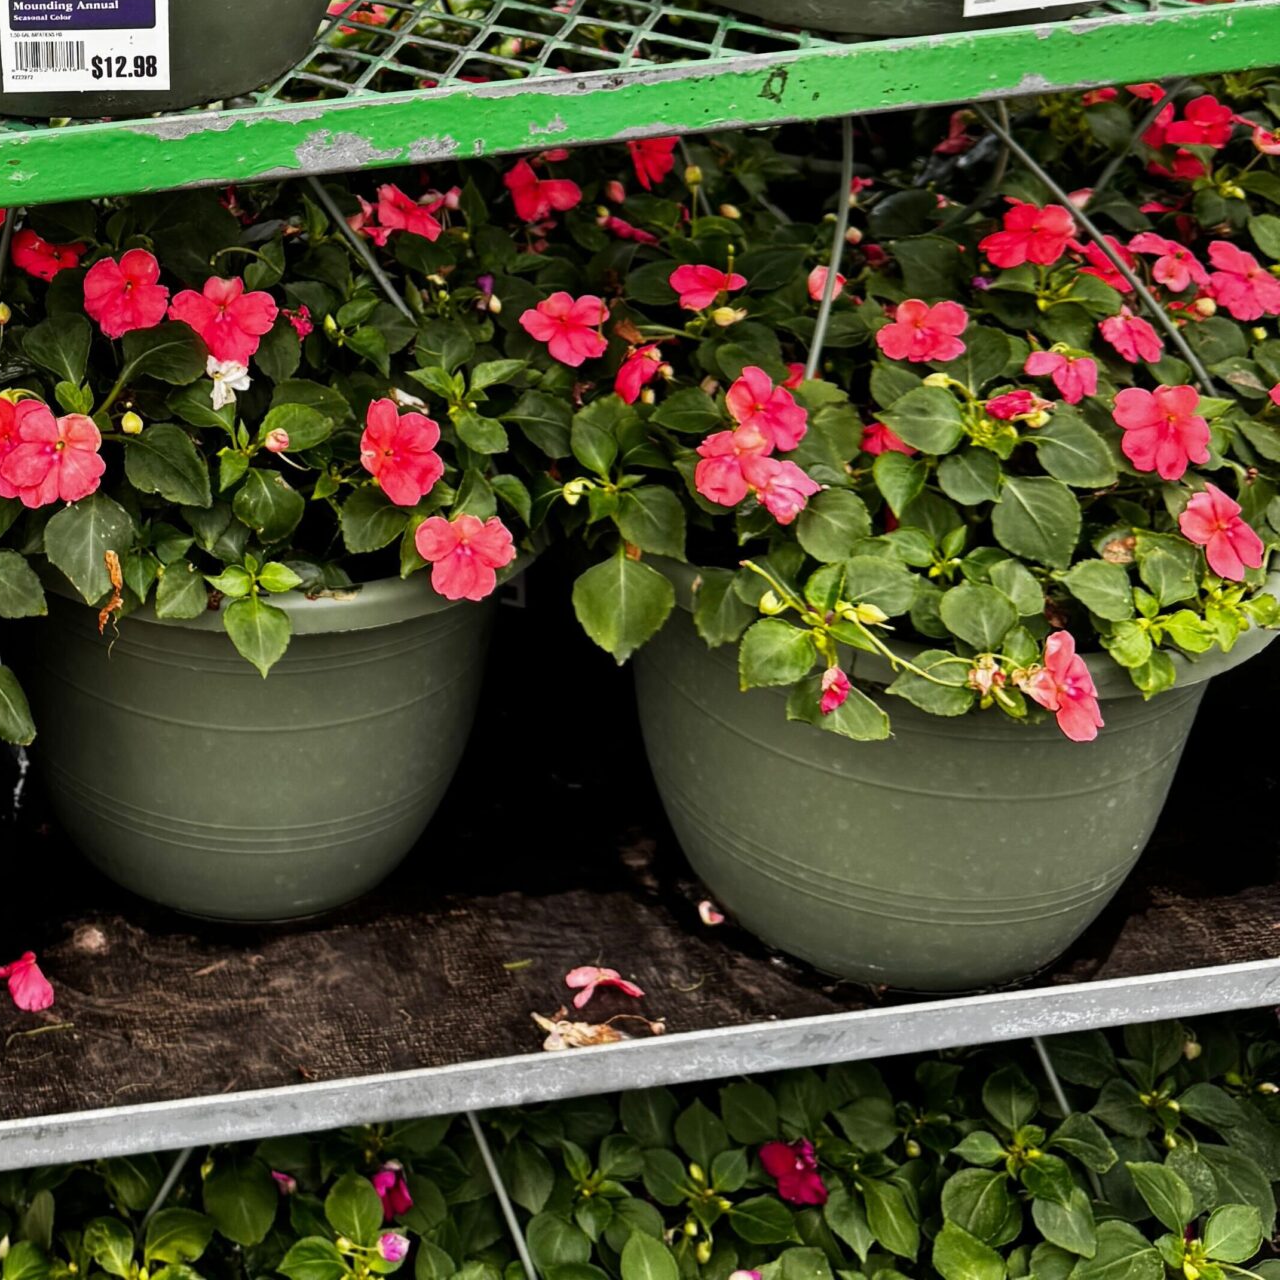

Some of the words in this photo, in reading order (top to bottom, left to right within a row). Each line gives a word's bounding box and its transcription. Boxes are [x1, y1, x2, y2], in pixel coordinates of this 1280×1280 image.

[14, 1, 73, 12] Mounding
[77, 0, 119, 10] Annual
[92, 55, 157, 80] $12.98
